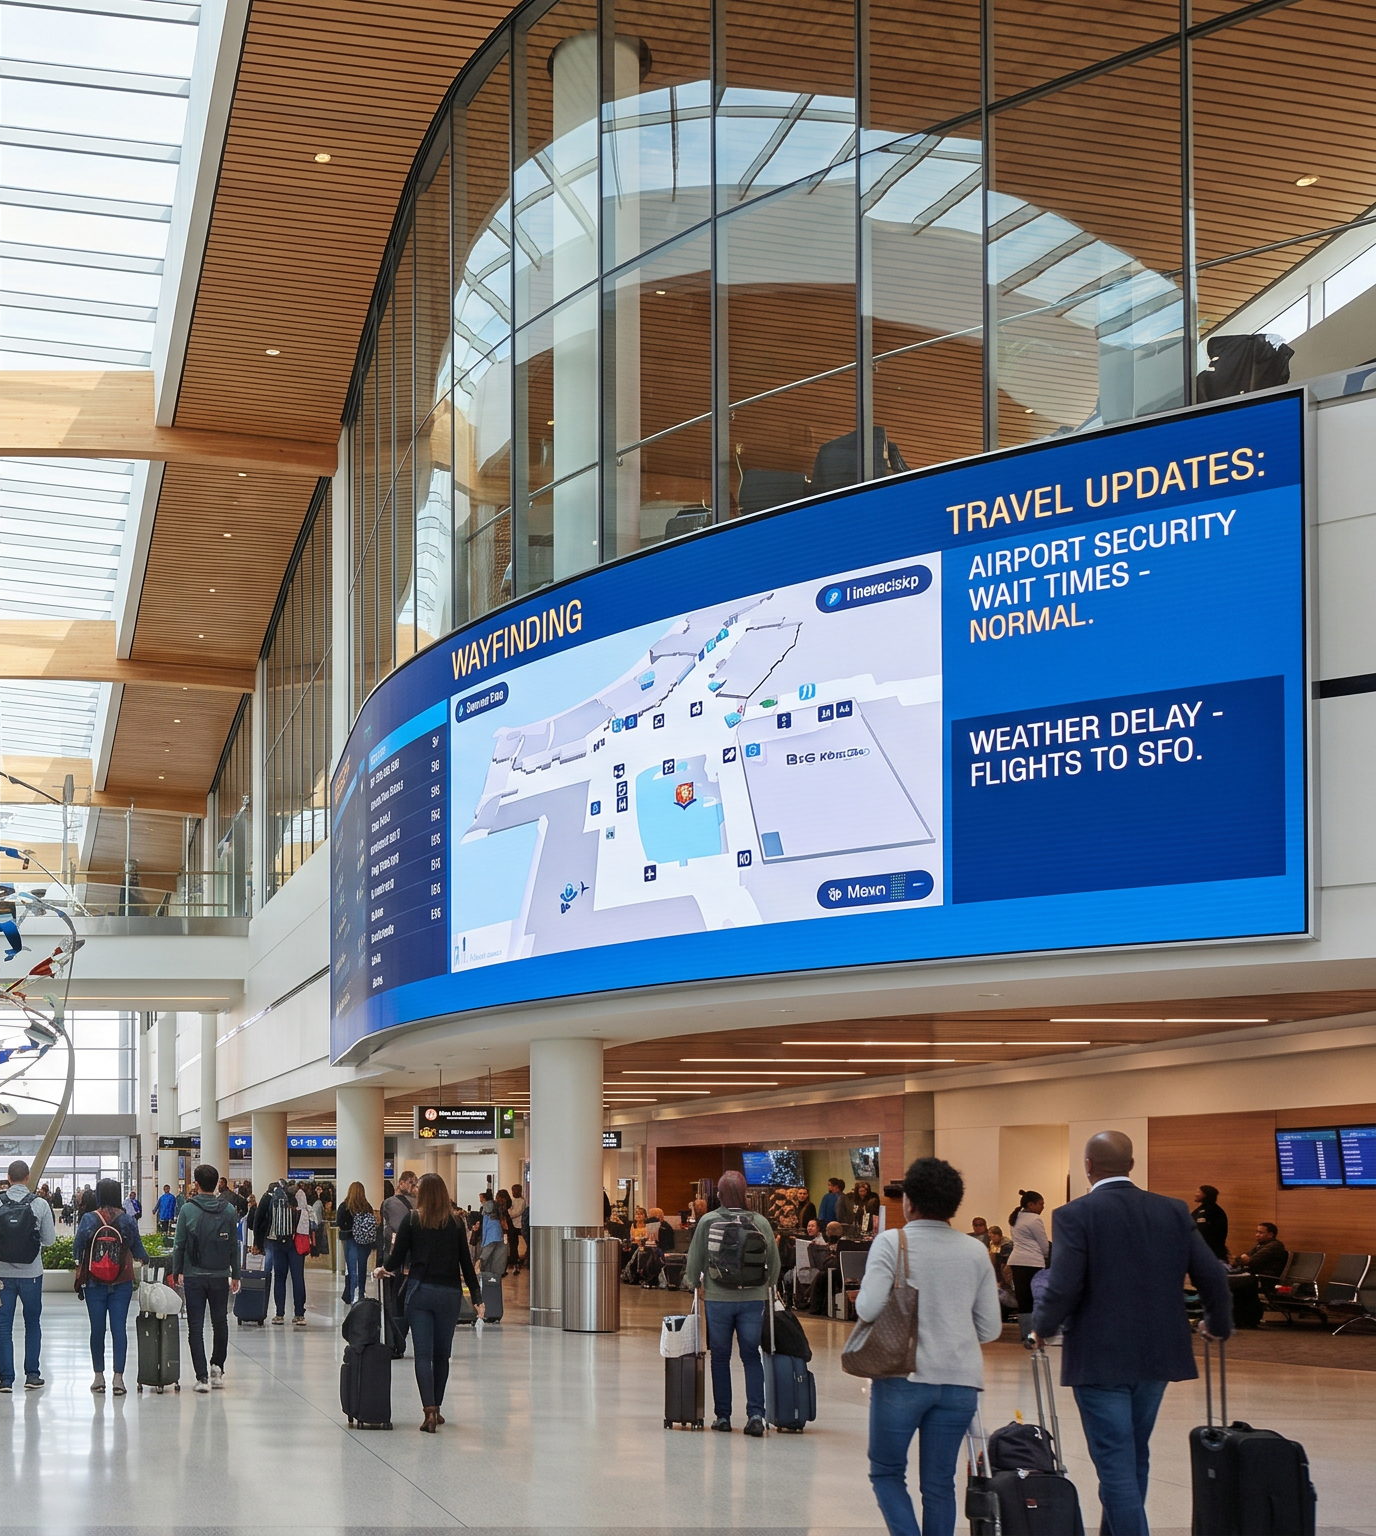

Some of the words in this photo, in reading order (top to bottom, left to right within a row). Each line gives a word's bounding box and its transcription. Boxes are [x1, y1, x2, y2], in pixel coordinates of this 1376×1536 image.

[945, 484, 1074, 535] TRAVEL
[1086, 447, 1265, 508] UPDATES:
[969, 535, 1086, 580] AIRPORT
[1094, 509, 1237, 558] SECURITY
[969, 577, 1037, 613] WAIT
[1042, 560, 1130, 599] TIMES
[451, 599, 583, 681] WAYFINDING
[970, 600, 1094, 644] NORMAL.
[970, 715, 1100, 755] WEATHER
[1110, 701, 1203, 738] DELAY
[971, 748, 1082, 787] FLIGHTS
[1090, 744, 1128, 772] TO
[1138, 736, 1203, 767] SFO.
